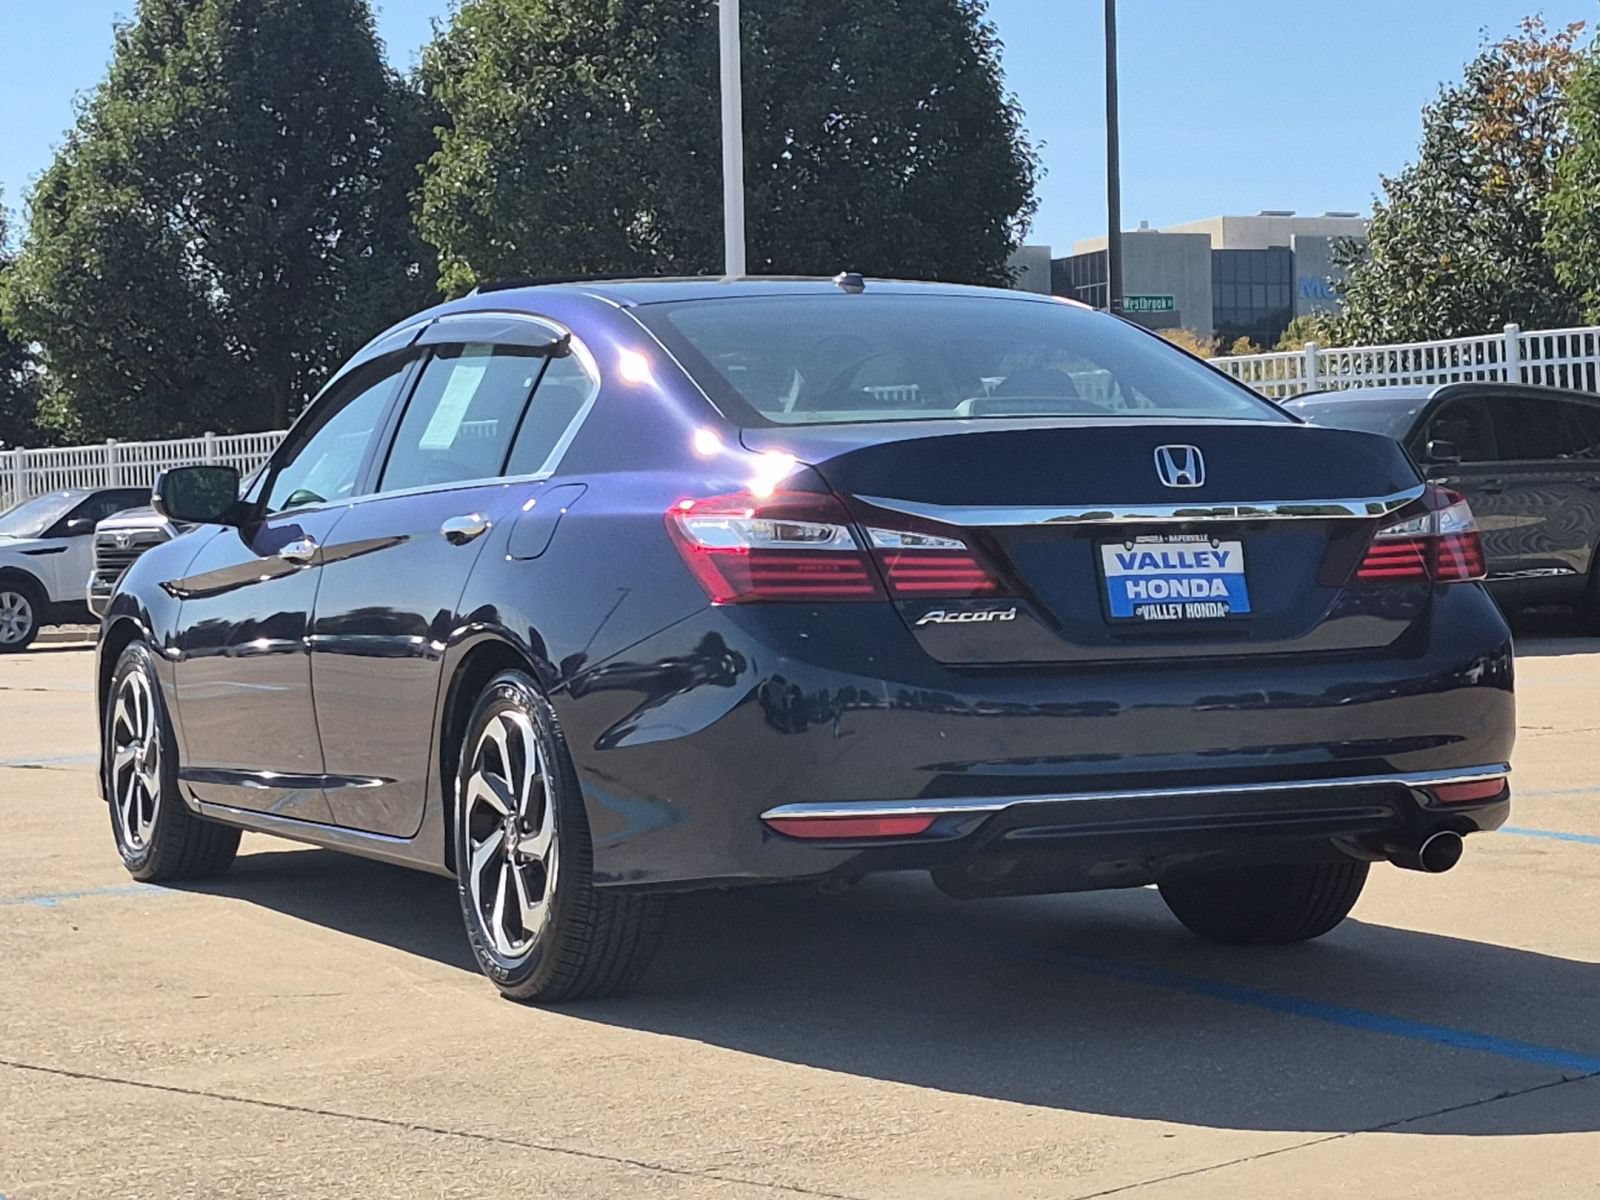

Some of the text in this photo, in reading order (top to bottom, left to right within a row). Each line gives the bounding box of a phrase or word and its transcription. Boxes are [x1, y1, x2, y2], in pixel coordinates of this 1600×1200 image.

[1115, 551, 1230, 570] VALLEY
[1126, 578, 1229, 599] HONDA
[915, 607, 1017, 625] Accord
[1142, 602, 1225, 620] VALLEY HONDA
